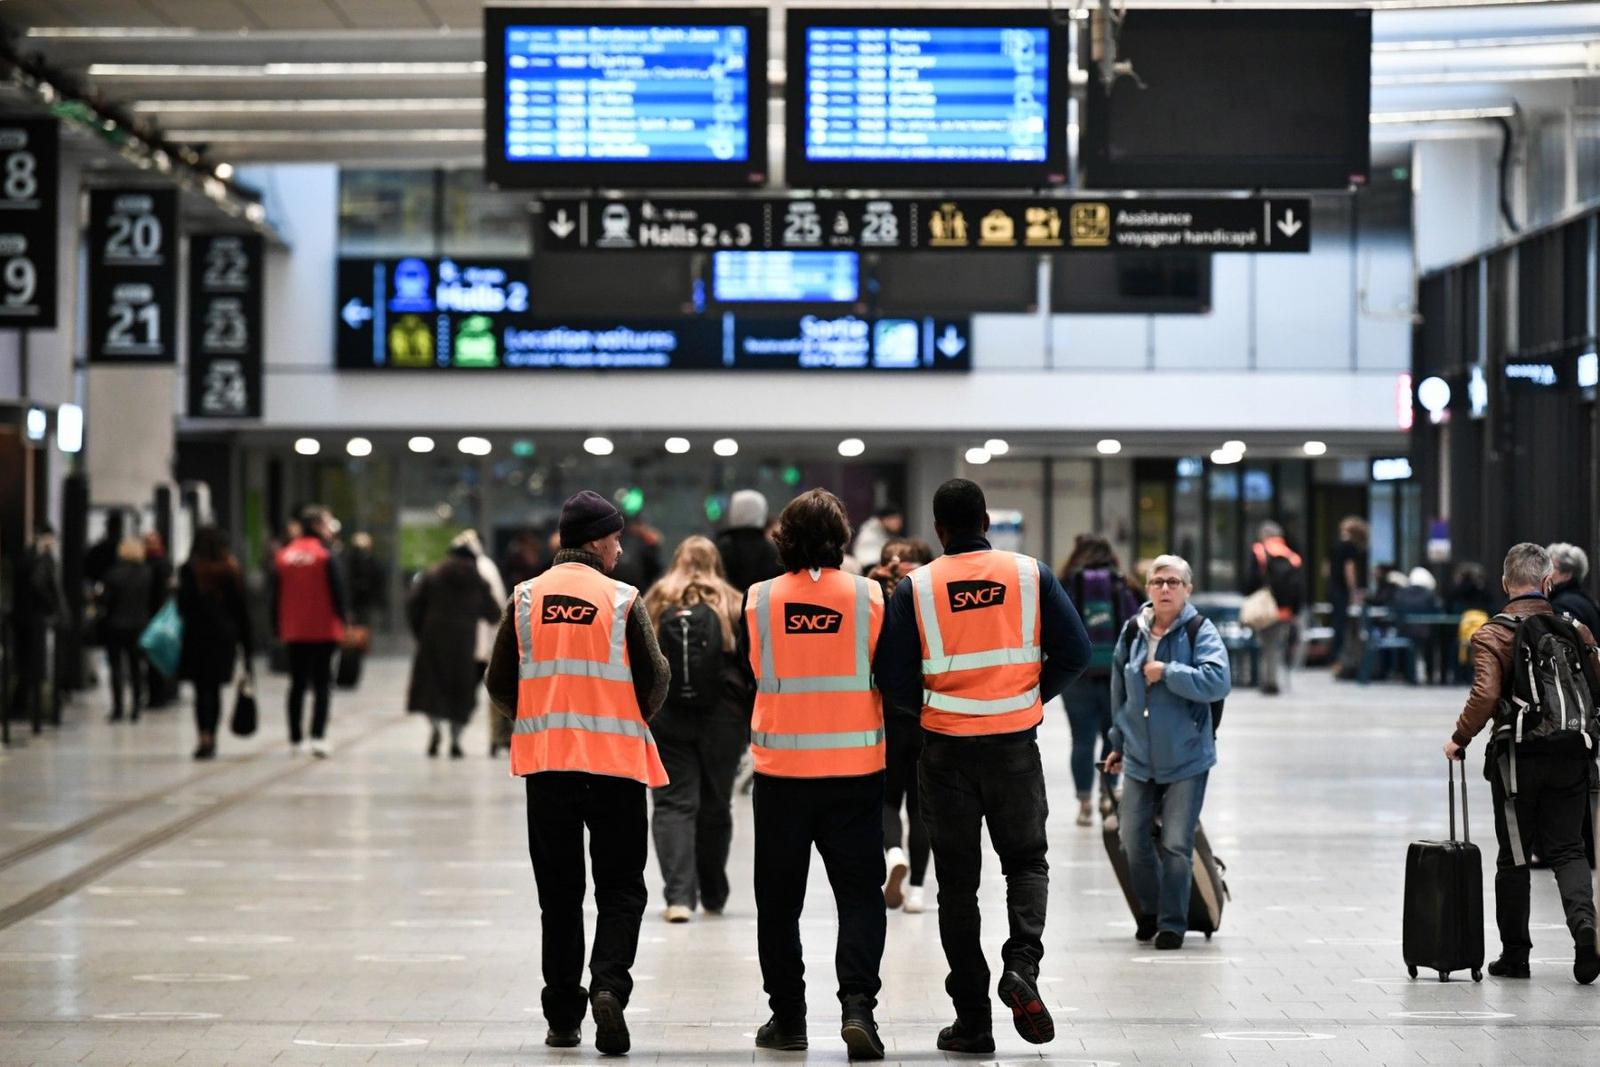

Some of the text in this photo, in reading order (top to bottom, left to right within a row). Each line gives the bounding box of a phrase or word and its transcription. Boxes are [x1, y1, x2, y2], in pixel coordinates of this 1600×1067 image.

[4, 151, 37, 198] 8
[784, 213, 822, 242] 25
[862, 213, 899, 242] 28
[1116, 210, 1193, 226] Assistance
[106, 215, 162, 258] 20
[701, 223, 717, 247] 2
[735, 223, 751, 247] 3
[4, 257, 37, 306] 9
[203, 249, 248, 286] 22
[506, 281, 528, 312] 2
[106, 303, 162, 348] 21
[203, 308, 248, 348] 23
[504, 326, 593, 351] Location
[203, 374, 248, 412] 24
[544, 605, 594, 620] SNCF
[953, 586, 1001, 608] SNCF
[788, 614, 839, 630] SNCF
